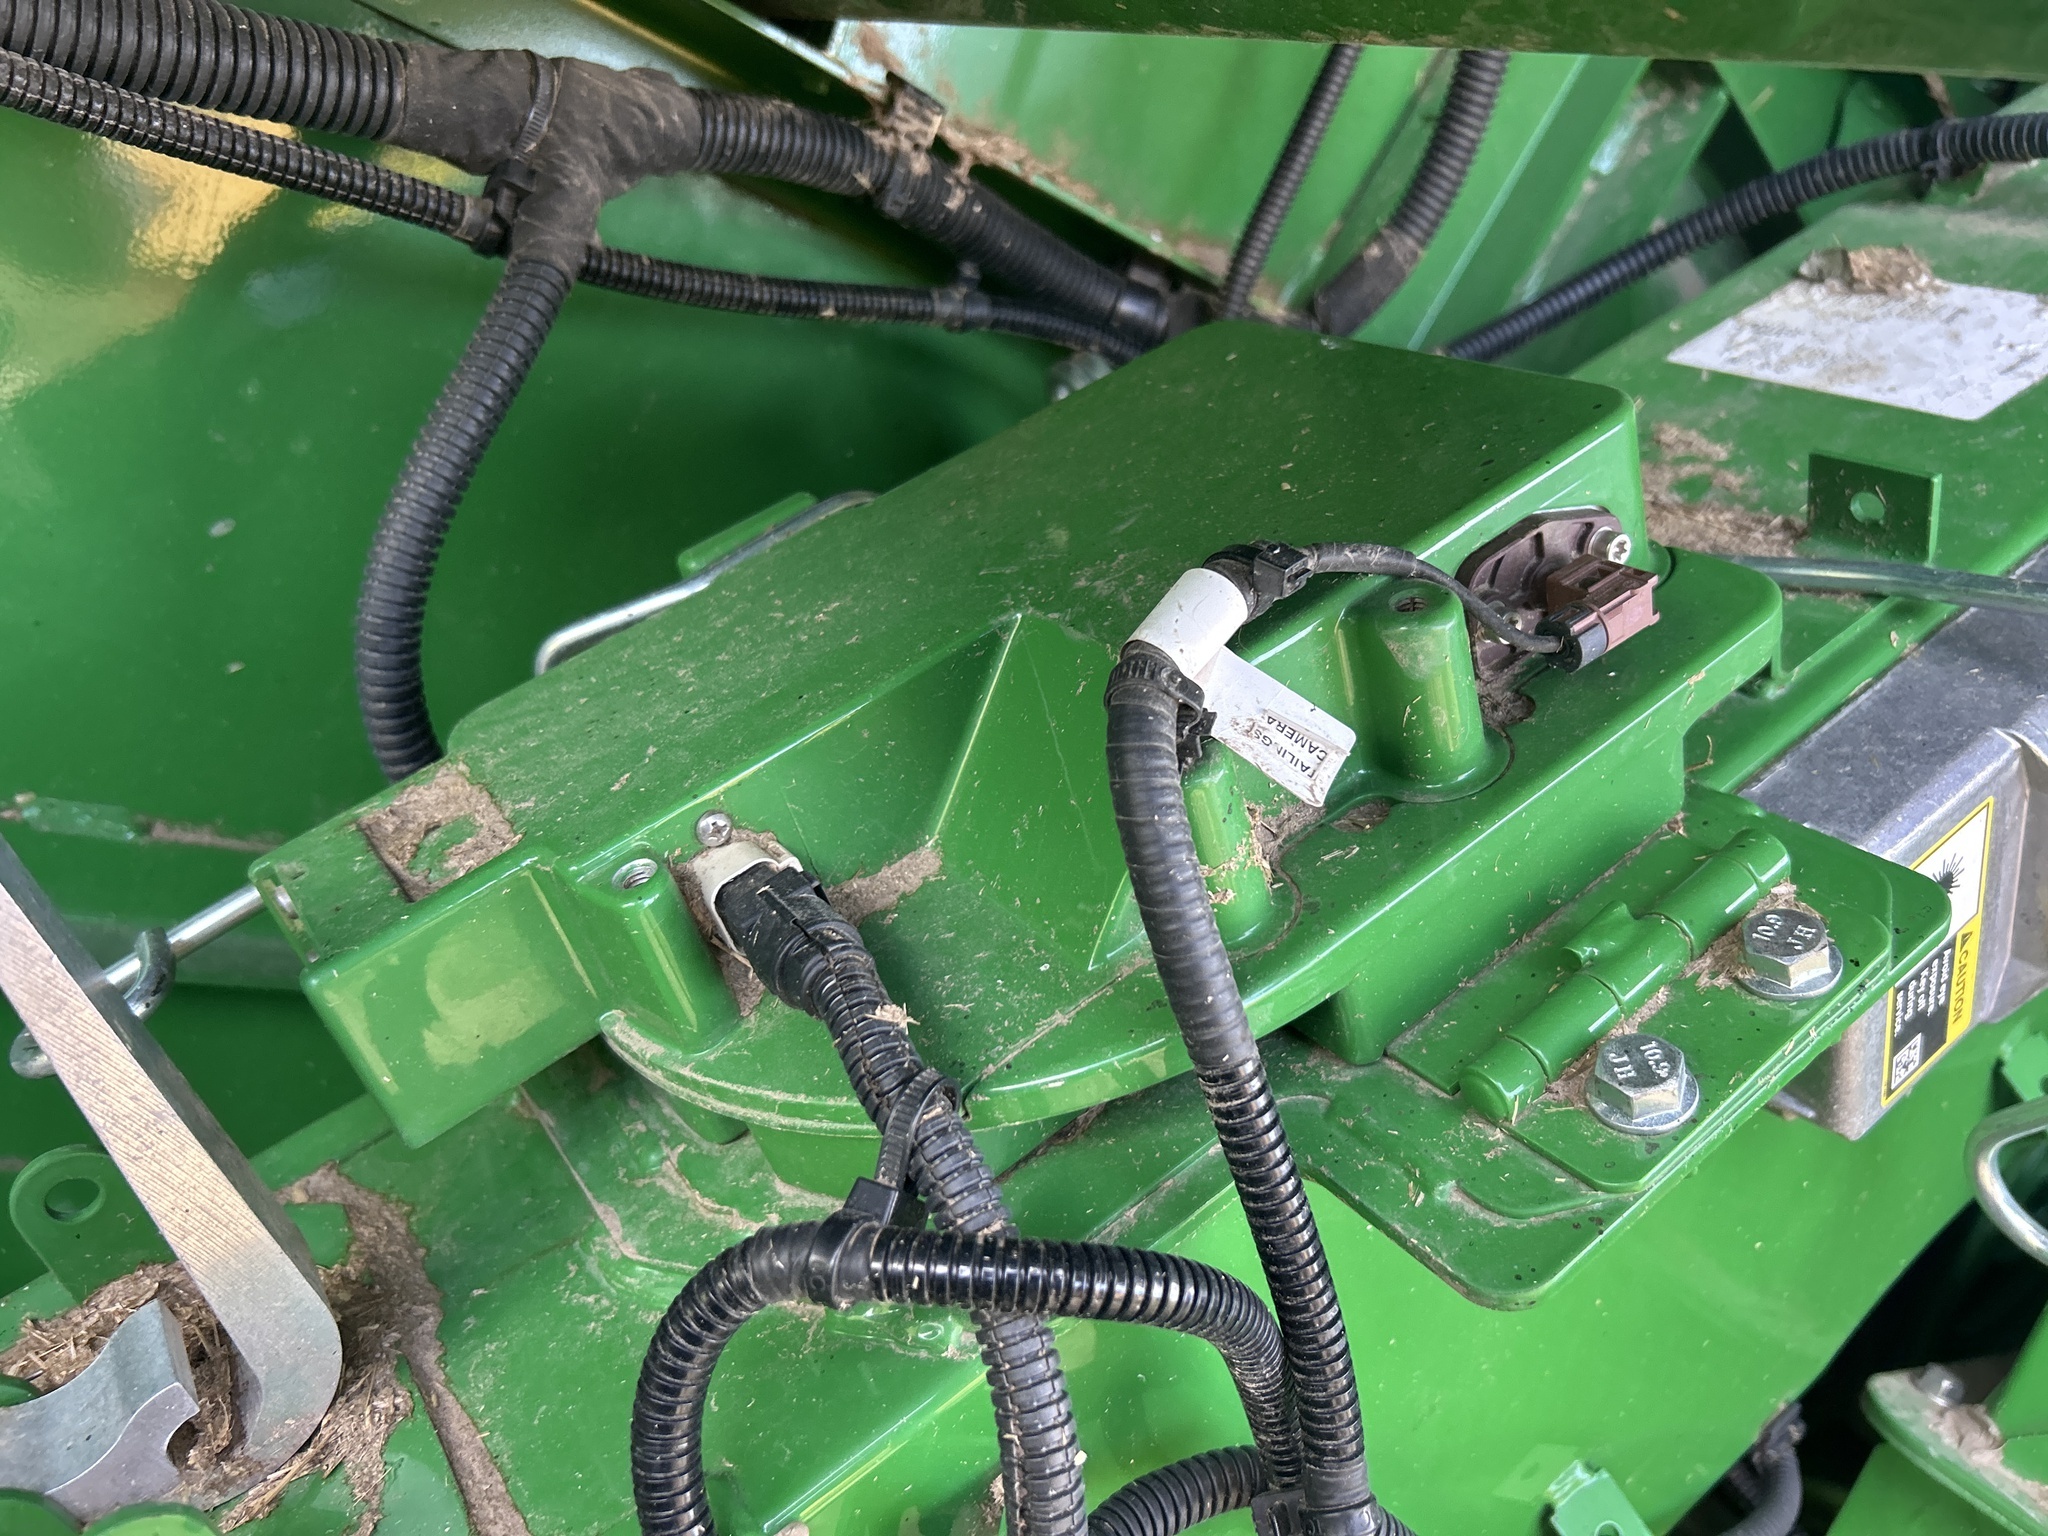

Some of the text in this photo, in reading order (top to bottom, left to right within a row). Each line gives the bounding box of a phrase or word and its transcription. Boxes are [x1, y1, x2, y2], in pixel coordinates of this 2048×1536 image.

[1253, 728, 1316, 779] TAILINGS
[1266, 715, 1328, 762] CAMERA
[1751, 913, 1783, 941] 10.9
[1904, 980, 1917, 1021] during
[1917, 967, 1929, 1012] Key off
[1937, 949, 1951, 1007] Avoid eye
[1952, 949, 1969, 1025] CAUTION
[1608, 1052, 1637, 1079] JH
[1639, 1040, 1671, 1078] 10.9
